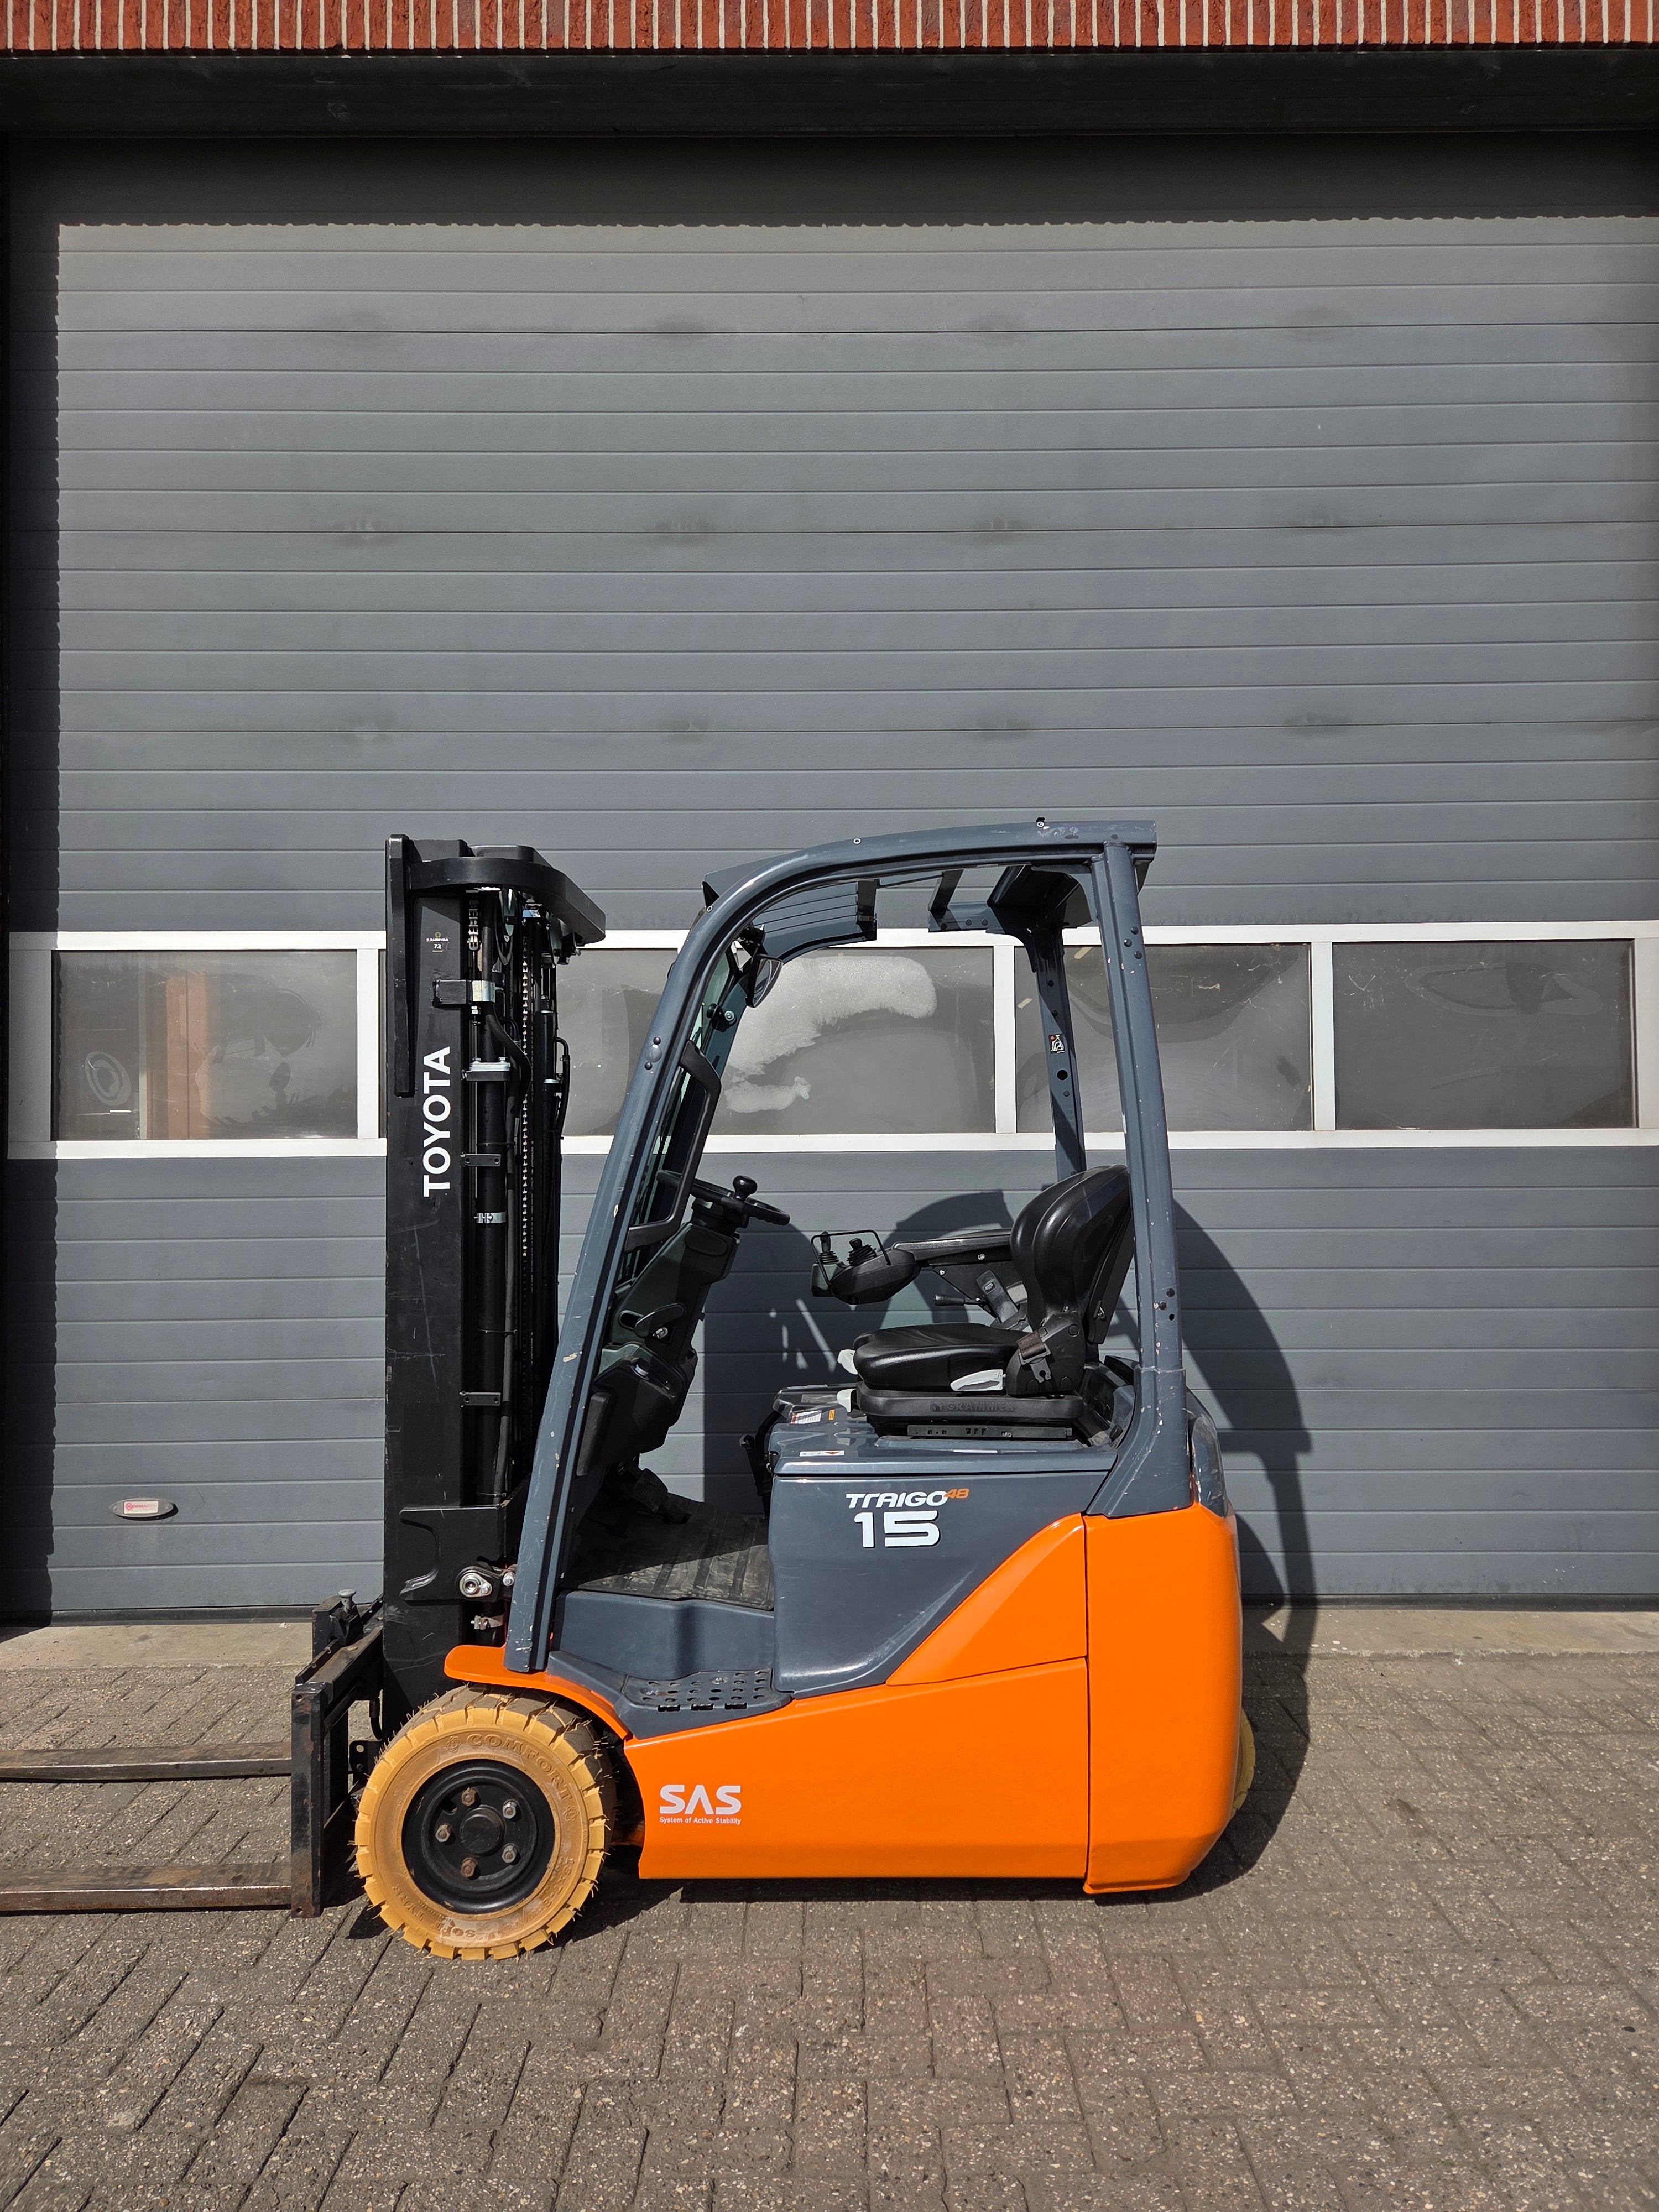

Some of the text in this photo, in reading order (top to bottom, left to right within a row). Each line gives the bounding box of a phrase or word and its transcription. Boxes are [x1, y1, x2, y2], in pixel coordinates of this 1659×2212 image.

[422, 1046, 451, 1197] TOYOTA
[947, 1401, 1014, 1412] GRAMMER
[846, 1488, 969, 1509] TRAIGO 48
[854, 1510, 940, 1548] 15
[467, 1733, 573, 1801] COMFORT
[659, 1784, 742, 1815] SAS
[389, 1882, 426, 1922] TYRE
